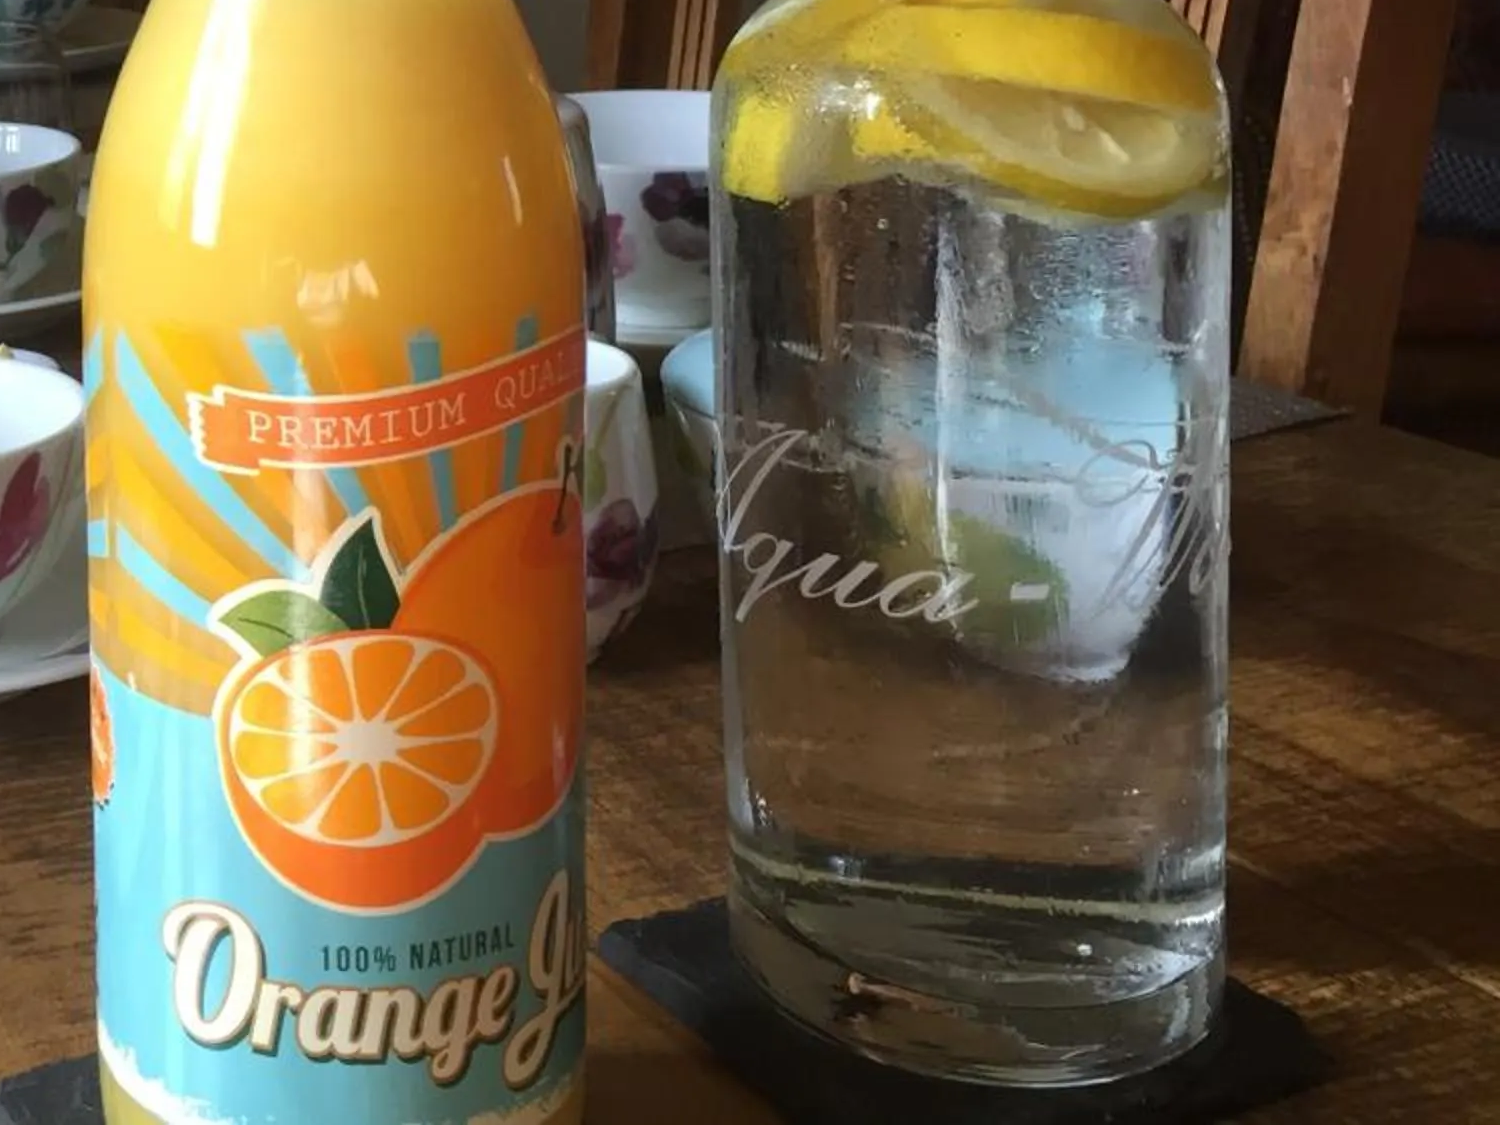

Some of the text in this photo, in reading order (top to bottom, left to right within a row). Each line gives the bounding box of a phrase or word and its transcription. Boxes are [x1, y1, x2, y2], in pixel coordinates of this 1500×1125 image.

[245, 392, 469, 451] PREMIUM
[319, 921, 517, 974] 100% NATURAL
[161, 899, 521, 1084] Orange
